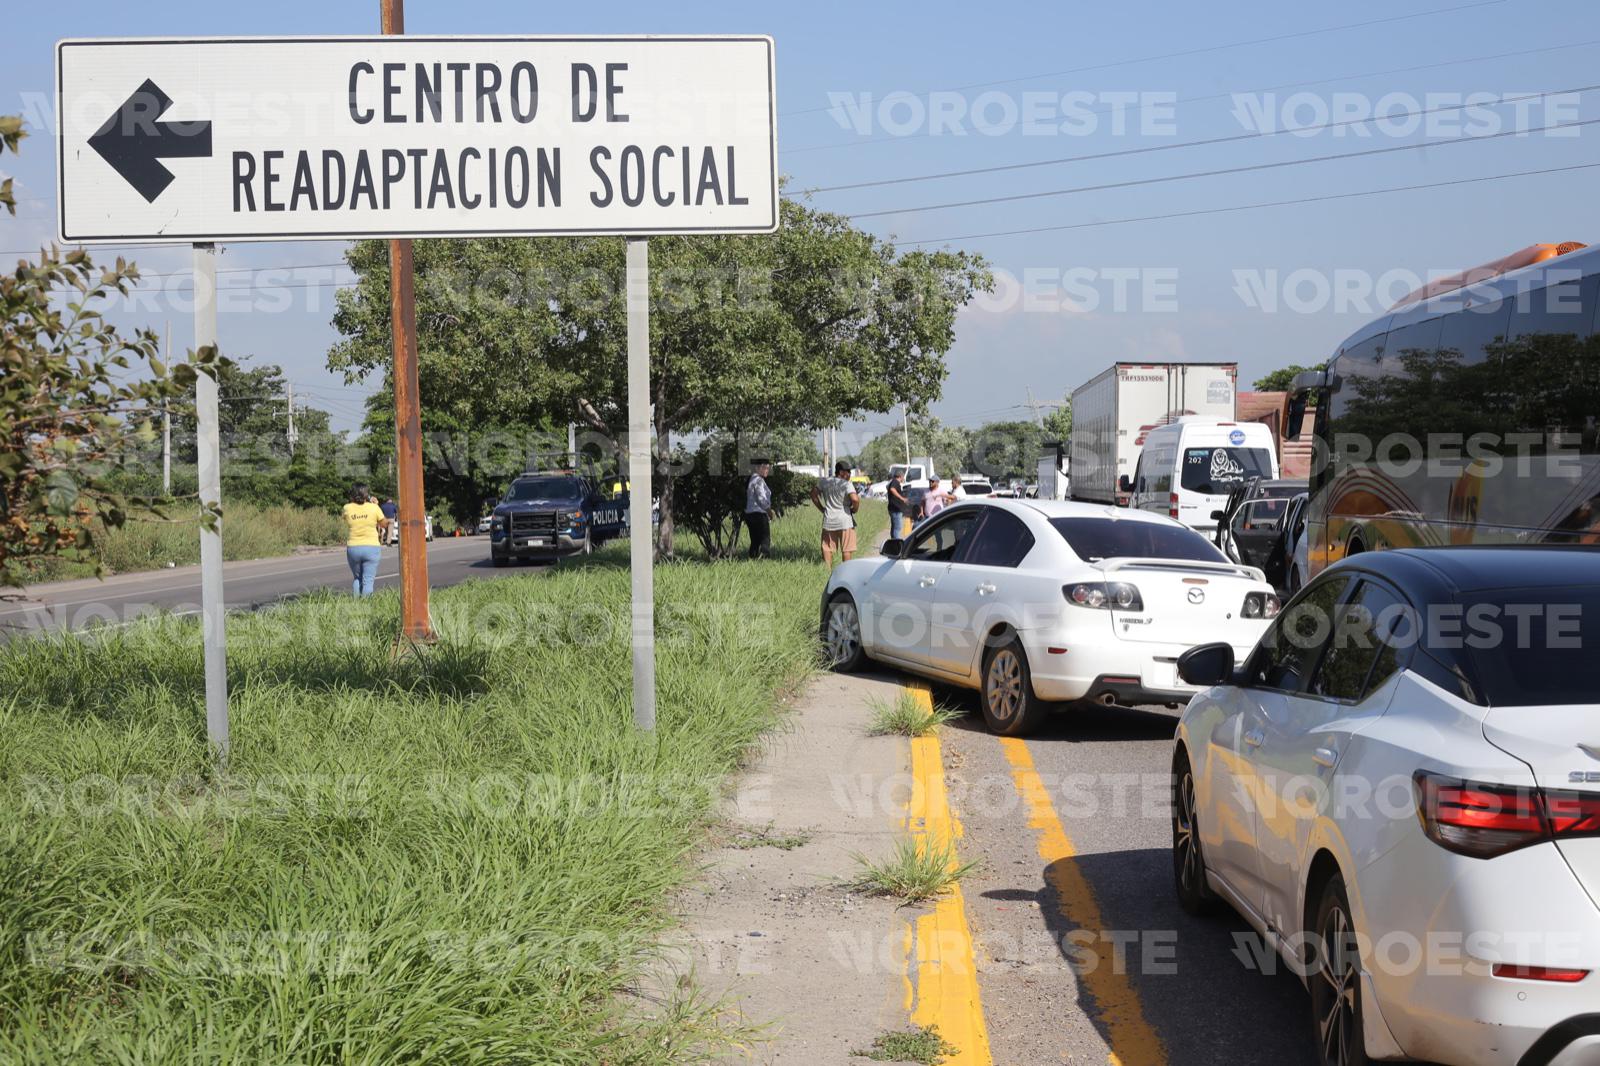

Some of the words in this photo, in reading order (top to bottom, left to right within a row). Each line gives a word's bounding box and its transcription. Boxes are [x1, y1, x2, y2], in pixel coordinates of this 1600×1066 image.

[349, 61, 538, 125] CENTRO
[571, 63, 630, 123] DE
[232, 145, 561, 213] READAPTACION
[589, 144, 749, 208] SOCIAL
[1188, 456, 1202, 464] 202
[592, 508, 619, 526] POLICIA
